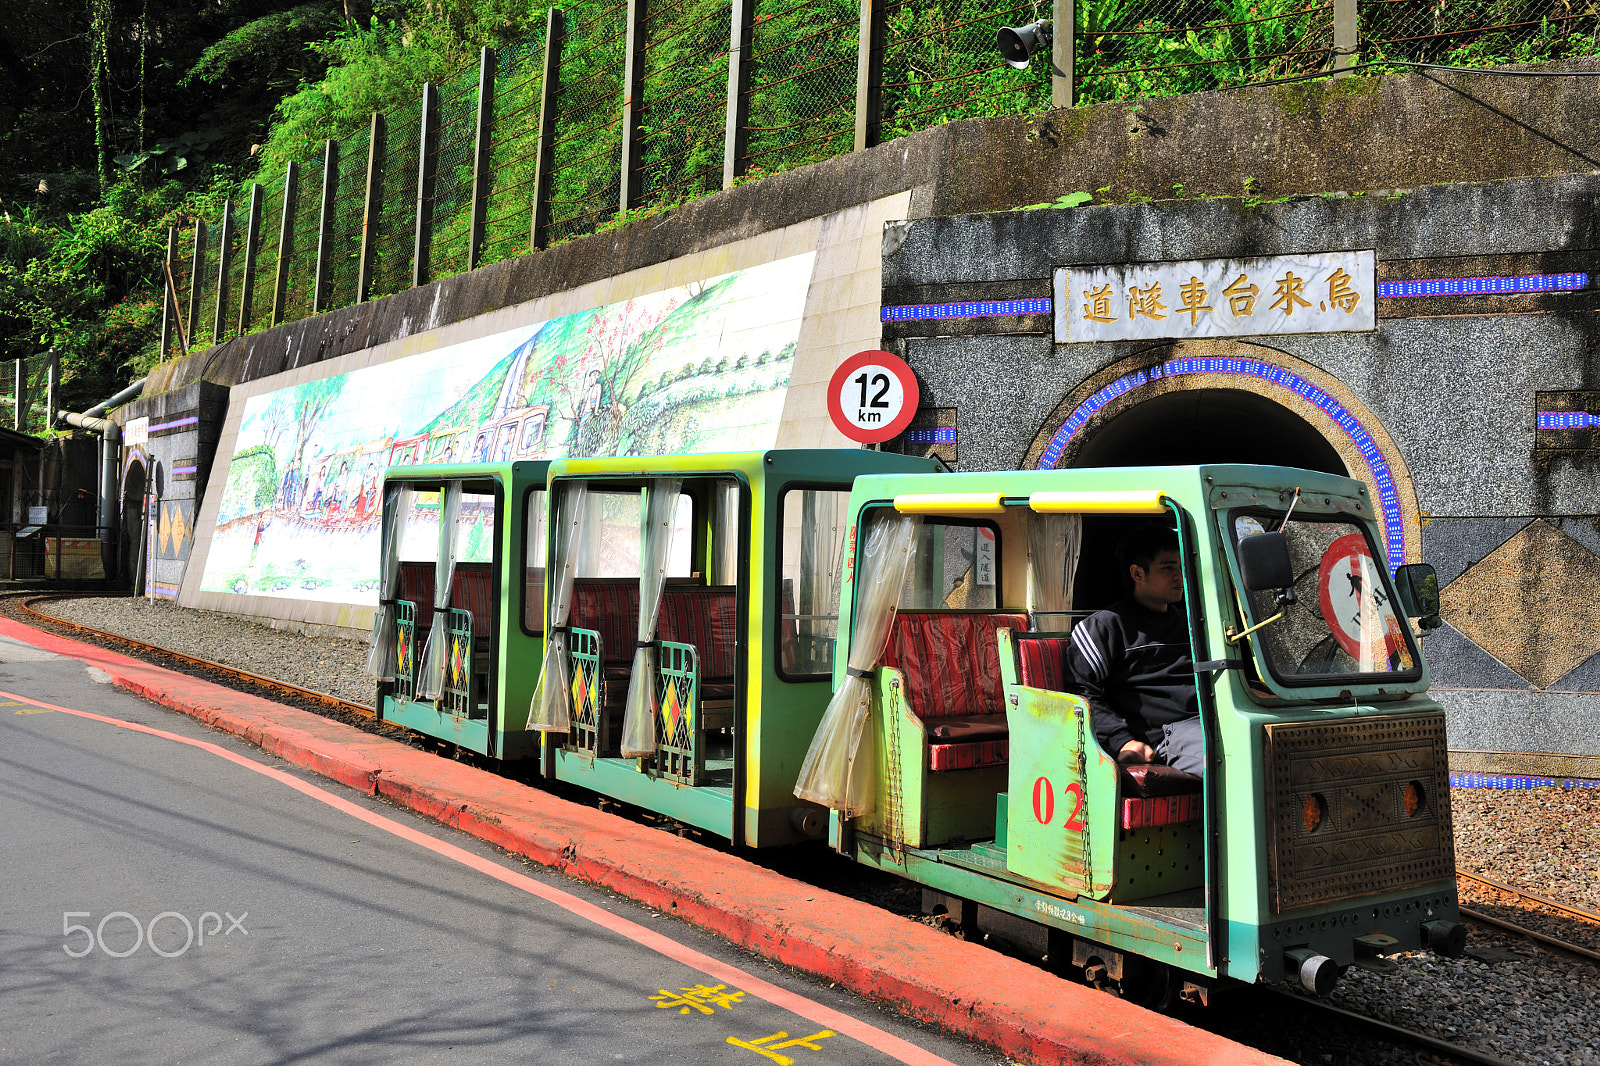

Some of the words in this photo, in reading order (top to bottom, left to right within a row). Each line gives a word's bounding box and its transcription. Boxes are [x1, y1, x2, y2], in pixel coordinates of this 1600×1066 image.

[1083, 267, 1361, 327] 烏來台車隧道
[855, 373, 890, 408] 12
[858, 409, 881, 422] km
[980, 543, 991, 582] 進入隧道
[1032, 776, 1085, 833] 02
